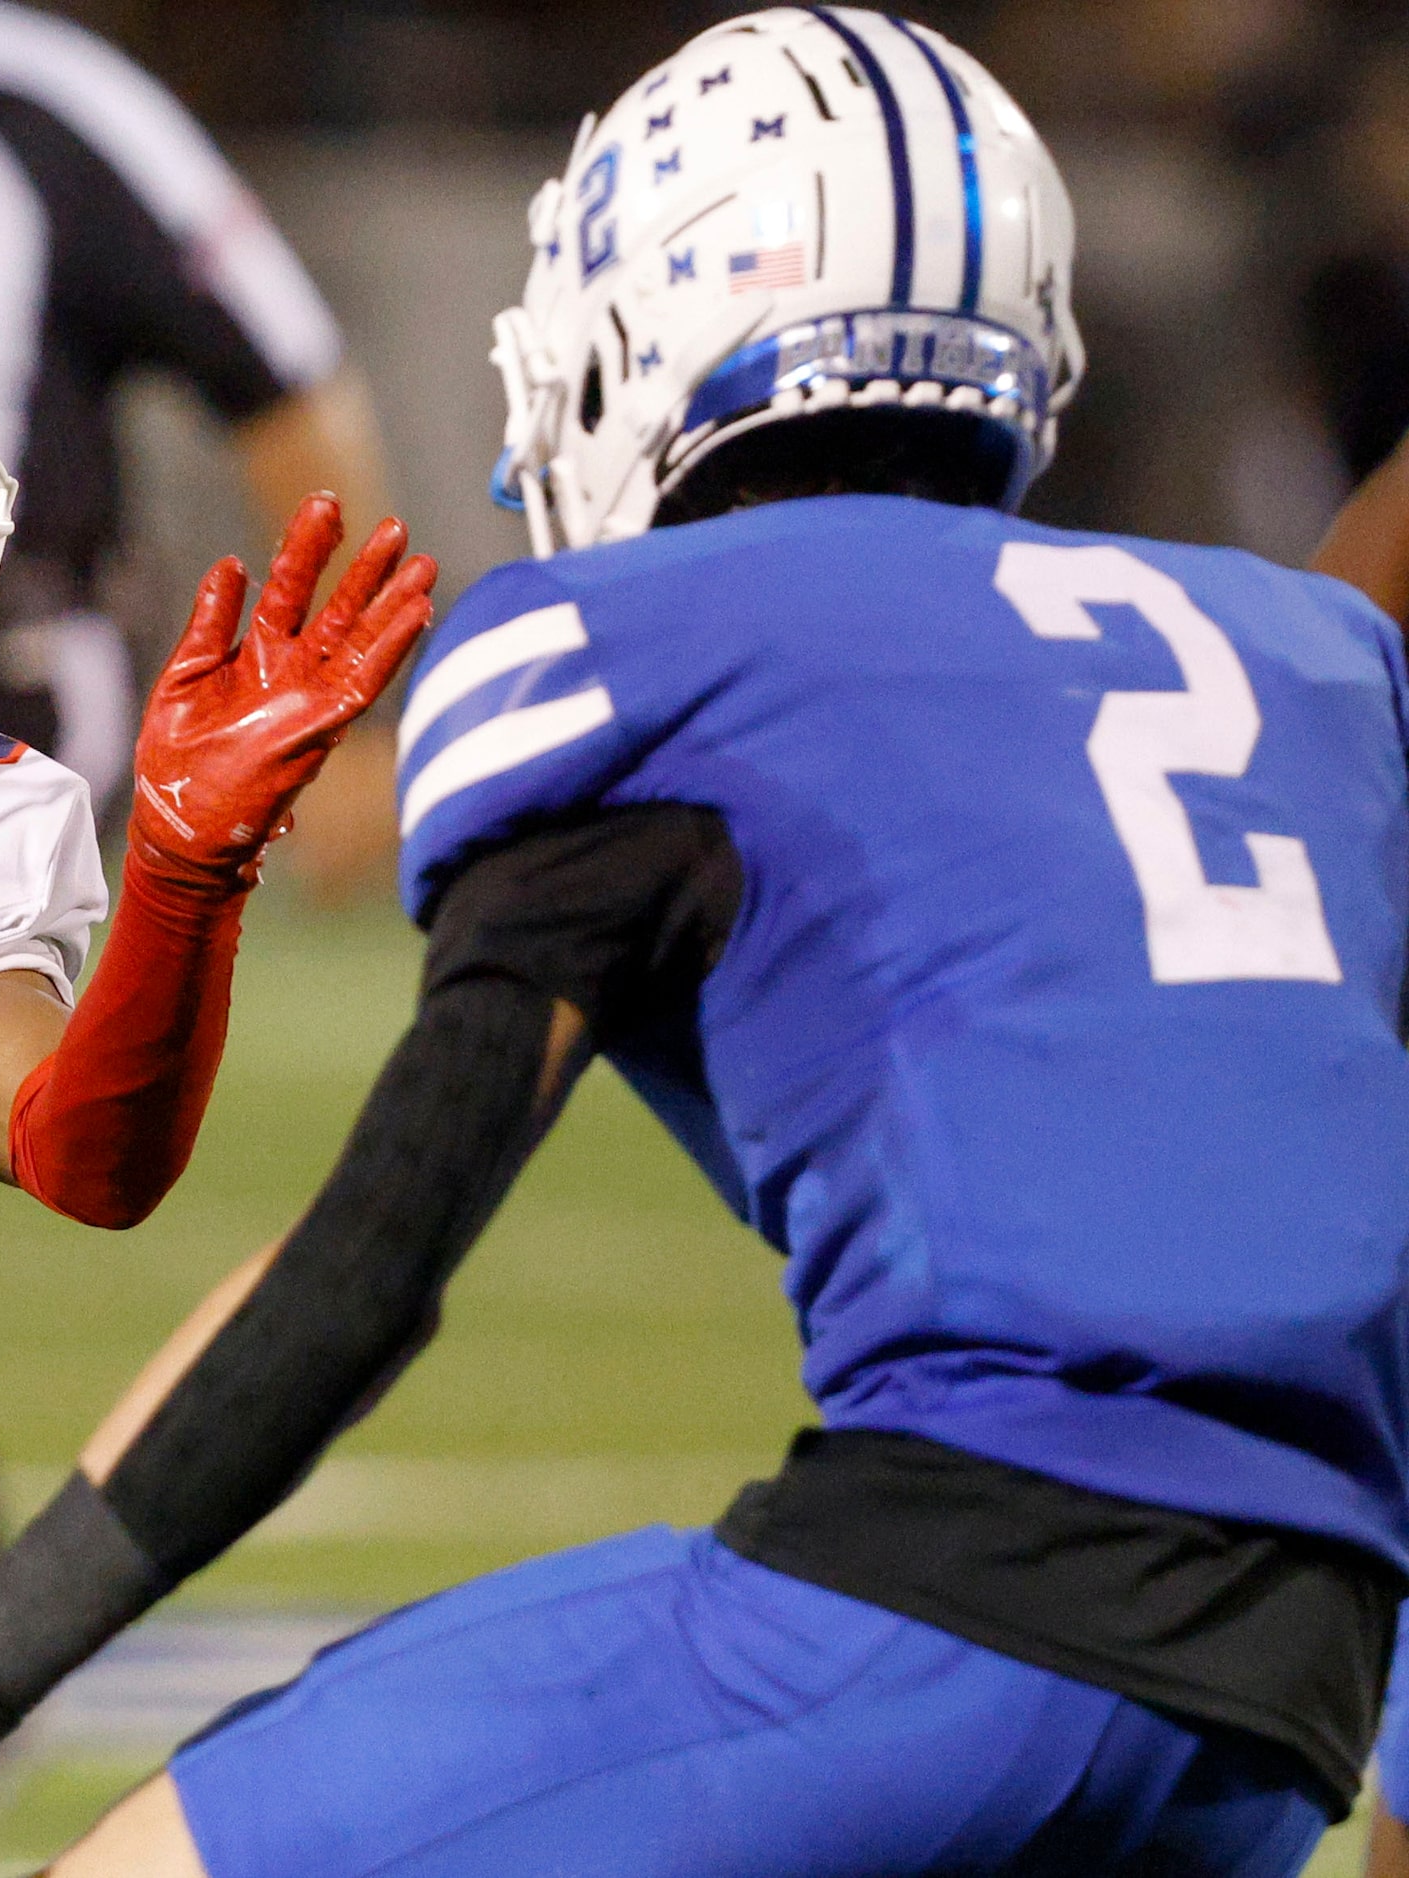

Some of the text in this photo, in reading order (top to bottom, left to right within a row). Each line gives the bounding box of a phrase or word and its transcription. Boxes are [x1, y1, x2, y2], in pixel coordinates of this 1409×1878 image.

[749, 112, 787, 143] M
[577, 144, 621, 289] 2
[994, 541, 1344, 985] 2
